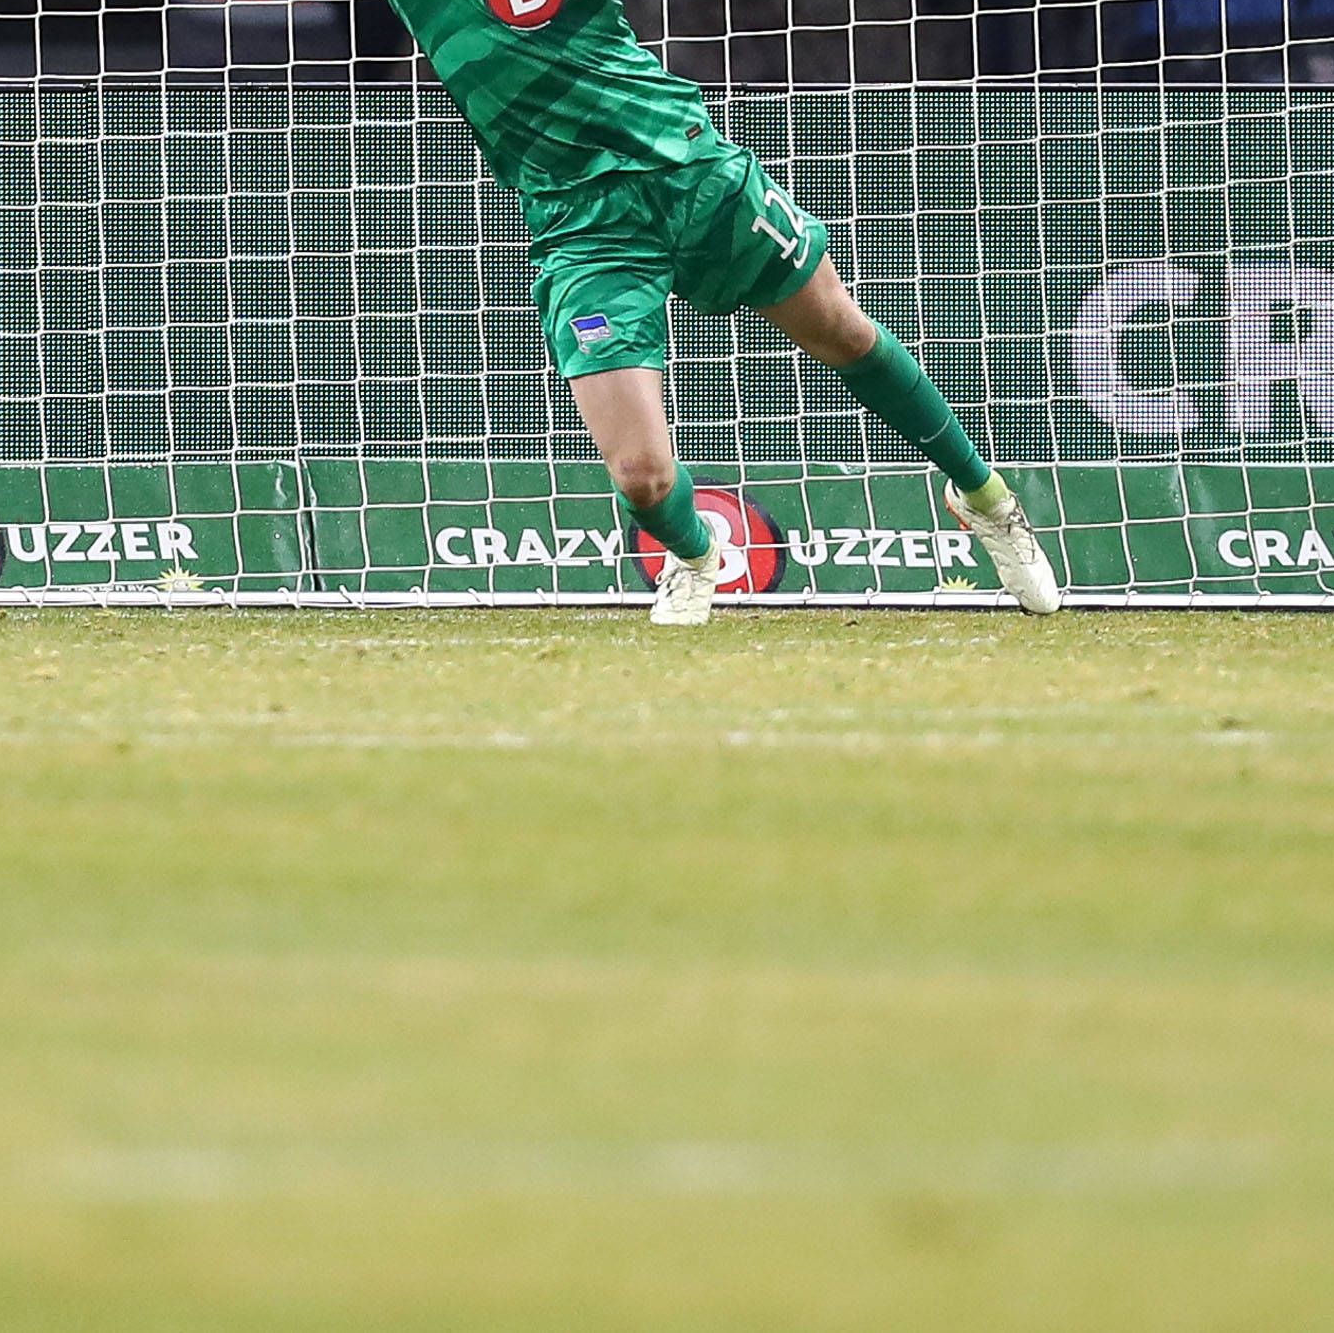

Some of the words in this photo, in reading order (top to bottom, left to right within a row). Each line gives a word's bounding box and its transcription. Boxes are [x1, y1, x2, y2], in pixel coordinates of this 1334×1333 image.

[8, 523, 199, 562] UZZER
[435, 526, 624, 567] CRAZY
[791, 529, 978, 568] UZZER
